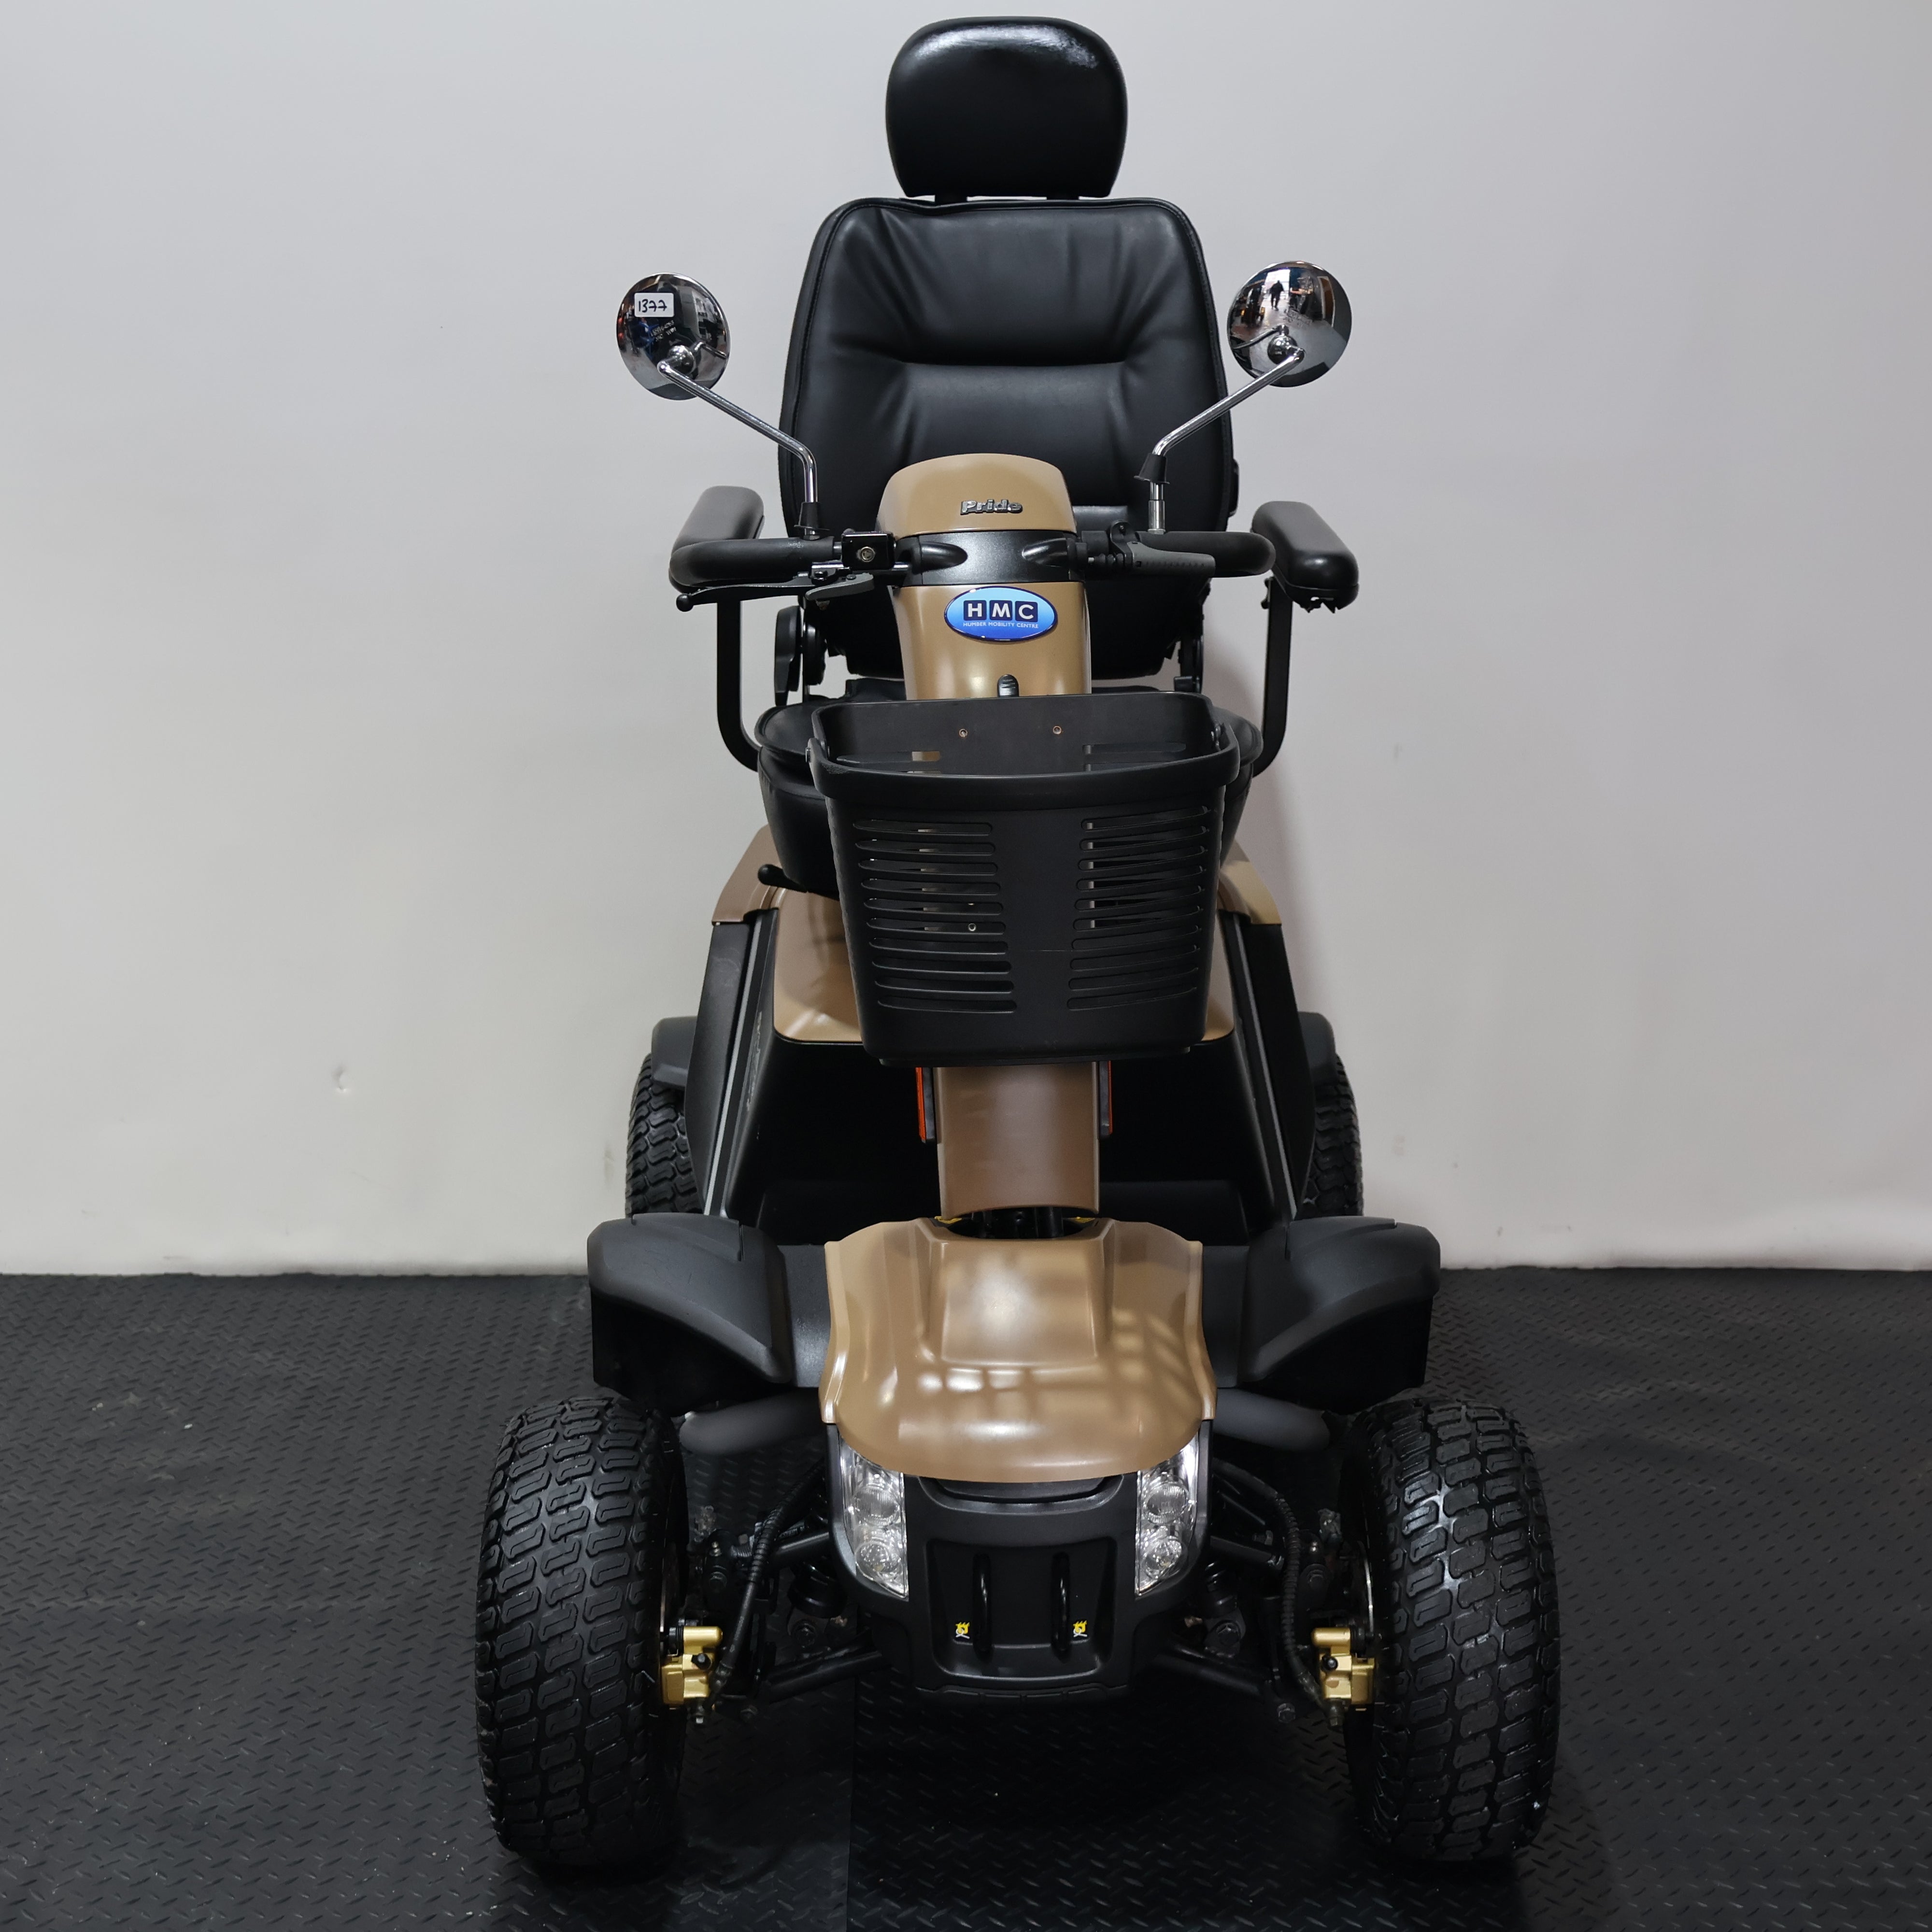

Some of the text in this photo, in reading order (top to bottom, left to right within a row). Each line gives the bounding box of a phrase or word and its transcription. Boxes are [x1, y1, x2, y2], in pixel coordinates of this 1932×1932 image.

[638, 298, 667, 313] 1377
[961, 499, 1023, 515] Pride
[967, 603, 1034, 620] HMC
